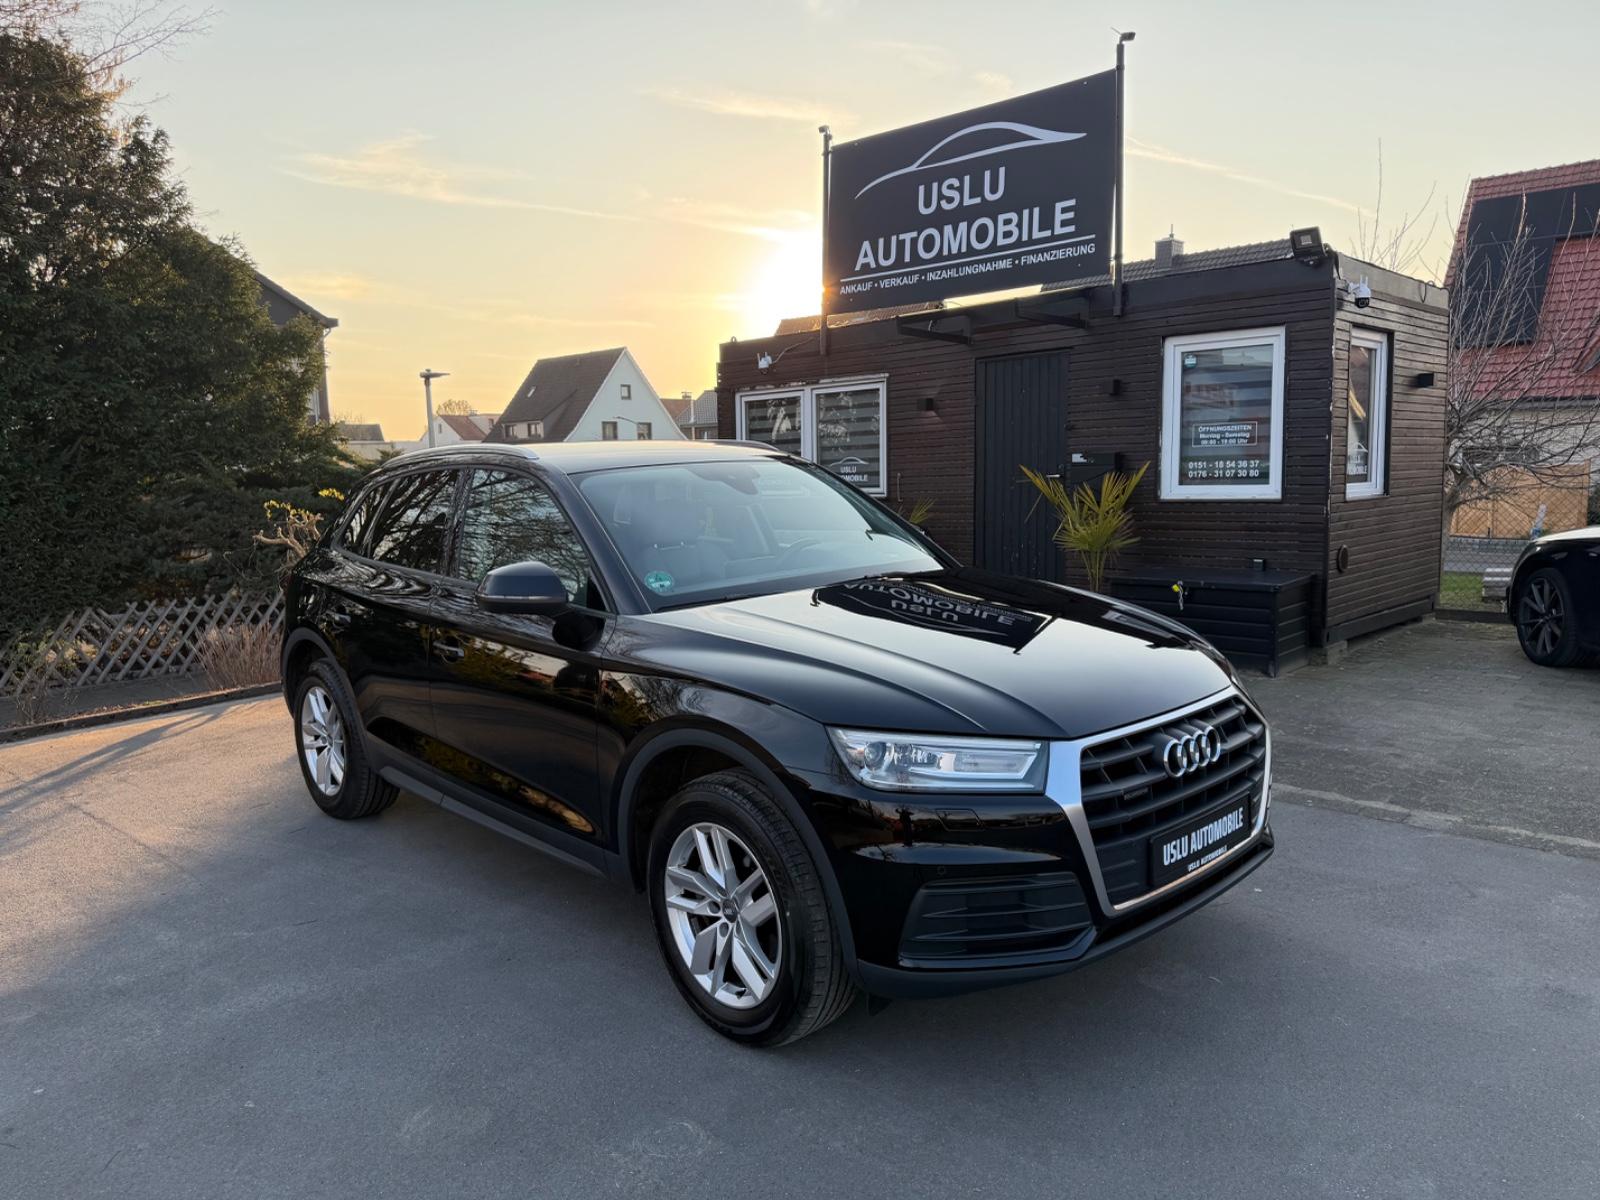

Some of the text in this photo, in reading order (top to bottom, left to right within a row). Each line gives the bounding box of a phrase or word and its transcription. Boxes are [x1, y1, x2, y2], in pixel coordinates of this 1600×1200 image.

[917, 166, 1006, 215] USLU
[854, 198, 1076, 271] AUTOMOBILE
[840, 243, 1096, 295] ANKAUF VERKAUF INZAHLUNGNAHME FINANZIERUNG
[840, 465, 857, 473] USLU
[1188, 461, 1207, 469] 0151
[1226, 460, 1236, 468] 54
[1214, 469, 1223, 477] 31
[1225, 469, 1235, 477] 07
[1237, 469, 1247, 477] 30
[1249, 469, 1259, 477] 80
[1163, 807, 1243, 866] USLU AUTOMOBILE
